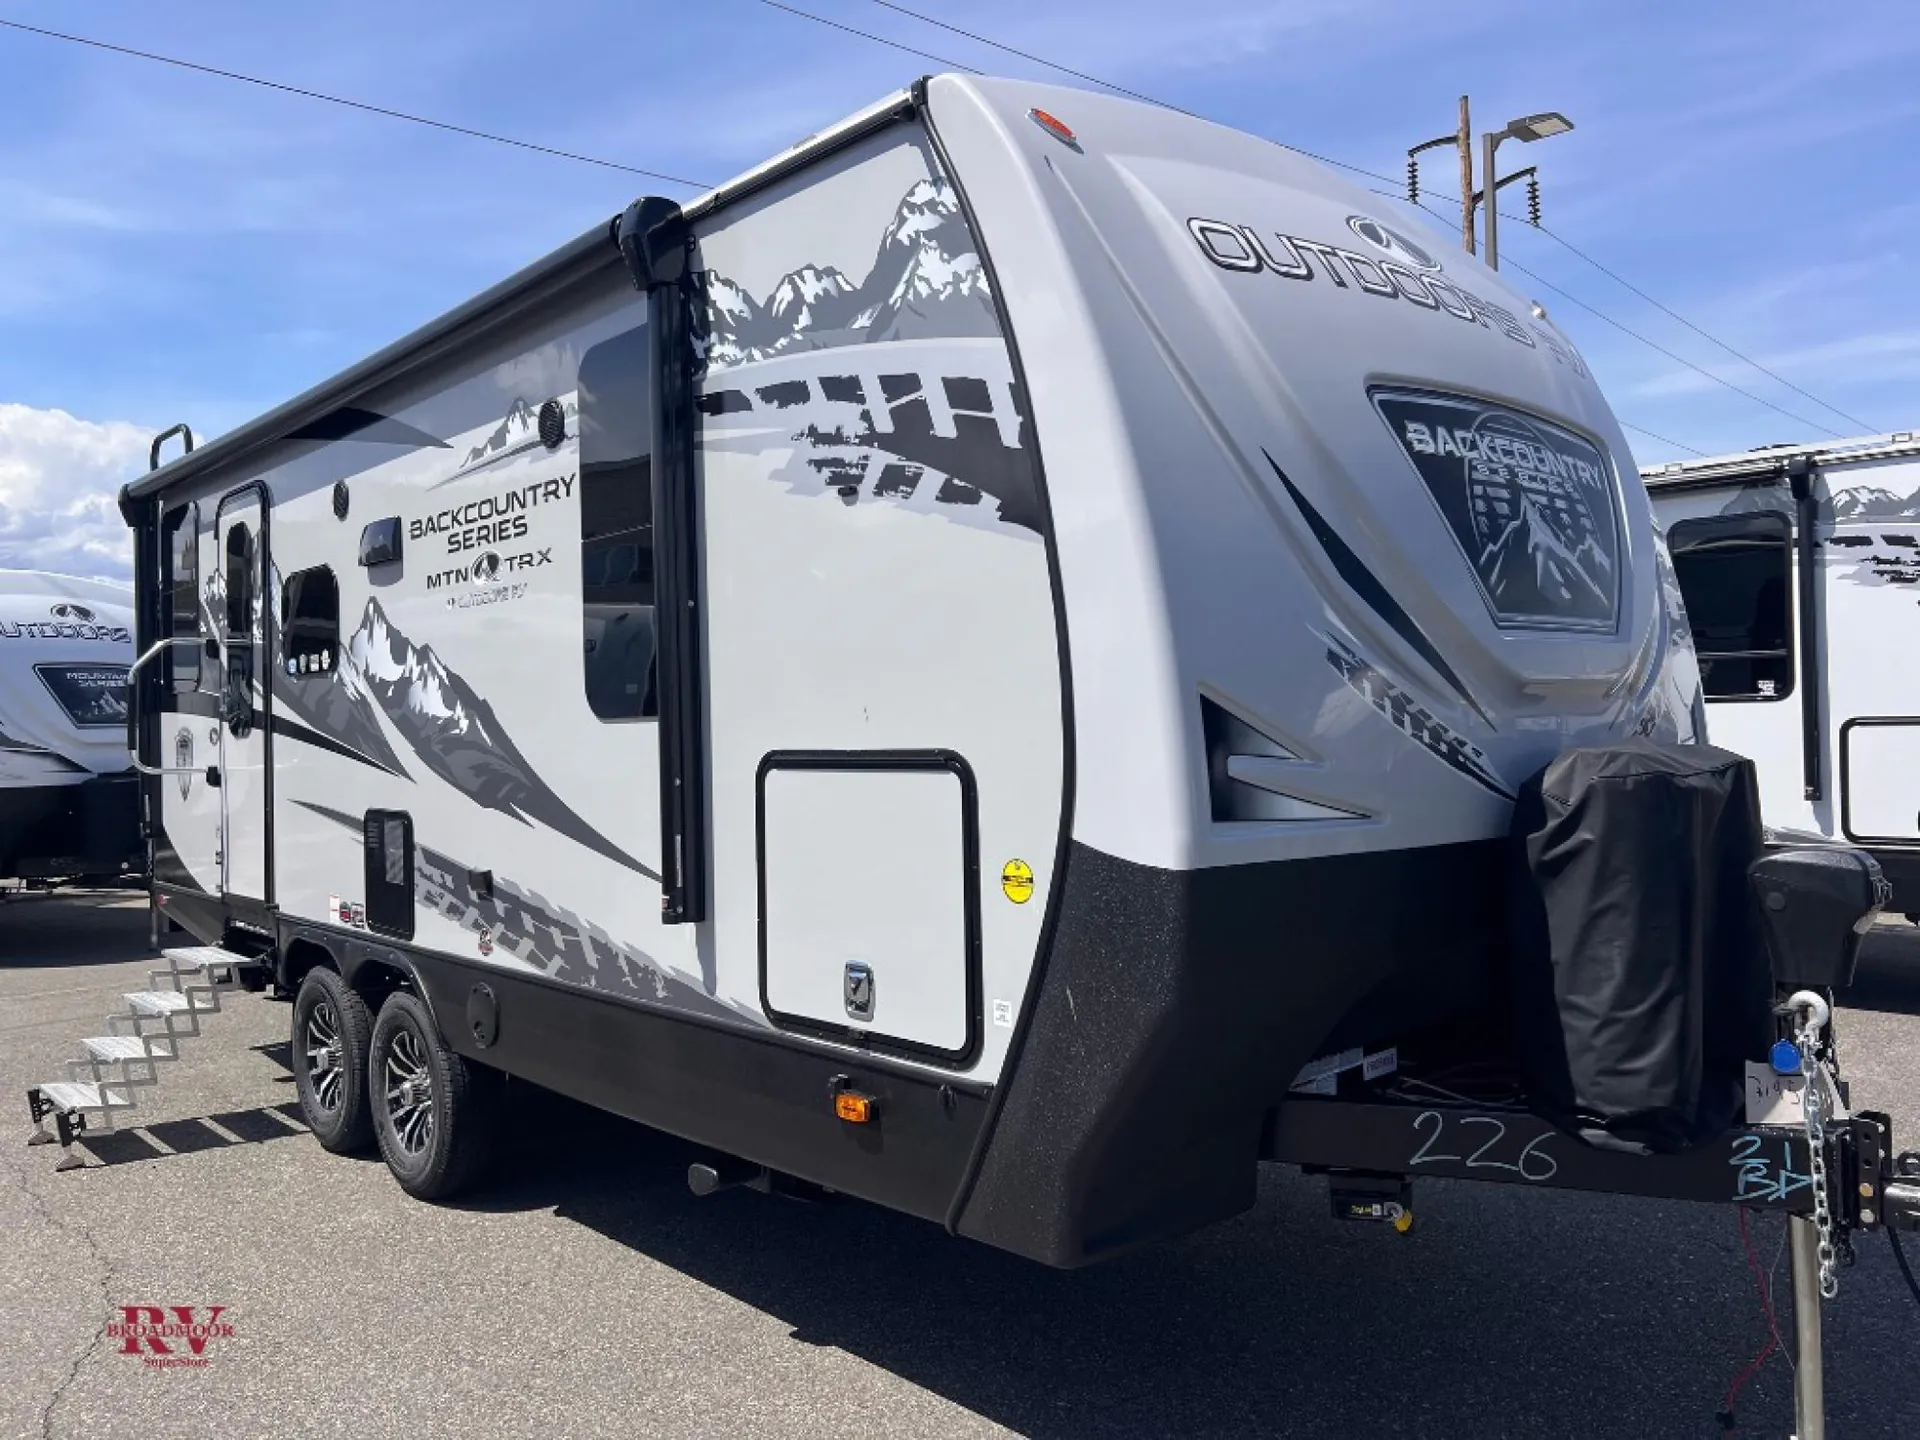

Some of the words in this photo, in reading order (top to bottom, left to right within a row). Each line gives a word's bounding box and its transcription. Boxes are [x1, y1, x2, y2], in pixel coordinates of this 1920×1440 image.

[1186, 216, 1536, 349] OUTDOORS
[1404, 420, 1602, 490] BACKCOUNTRY
[409, 472, 576, 540] BACKCOUNTRY
[447, 515, 528, 554] SERIES
[426, 567, 469, 589] MTN
[505, 547, 553, 572] TRX
[0, 622, 132, 643] UTDOORS
[1409, 1111, 1557, 1180] 226
